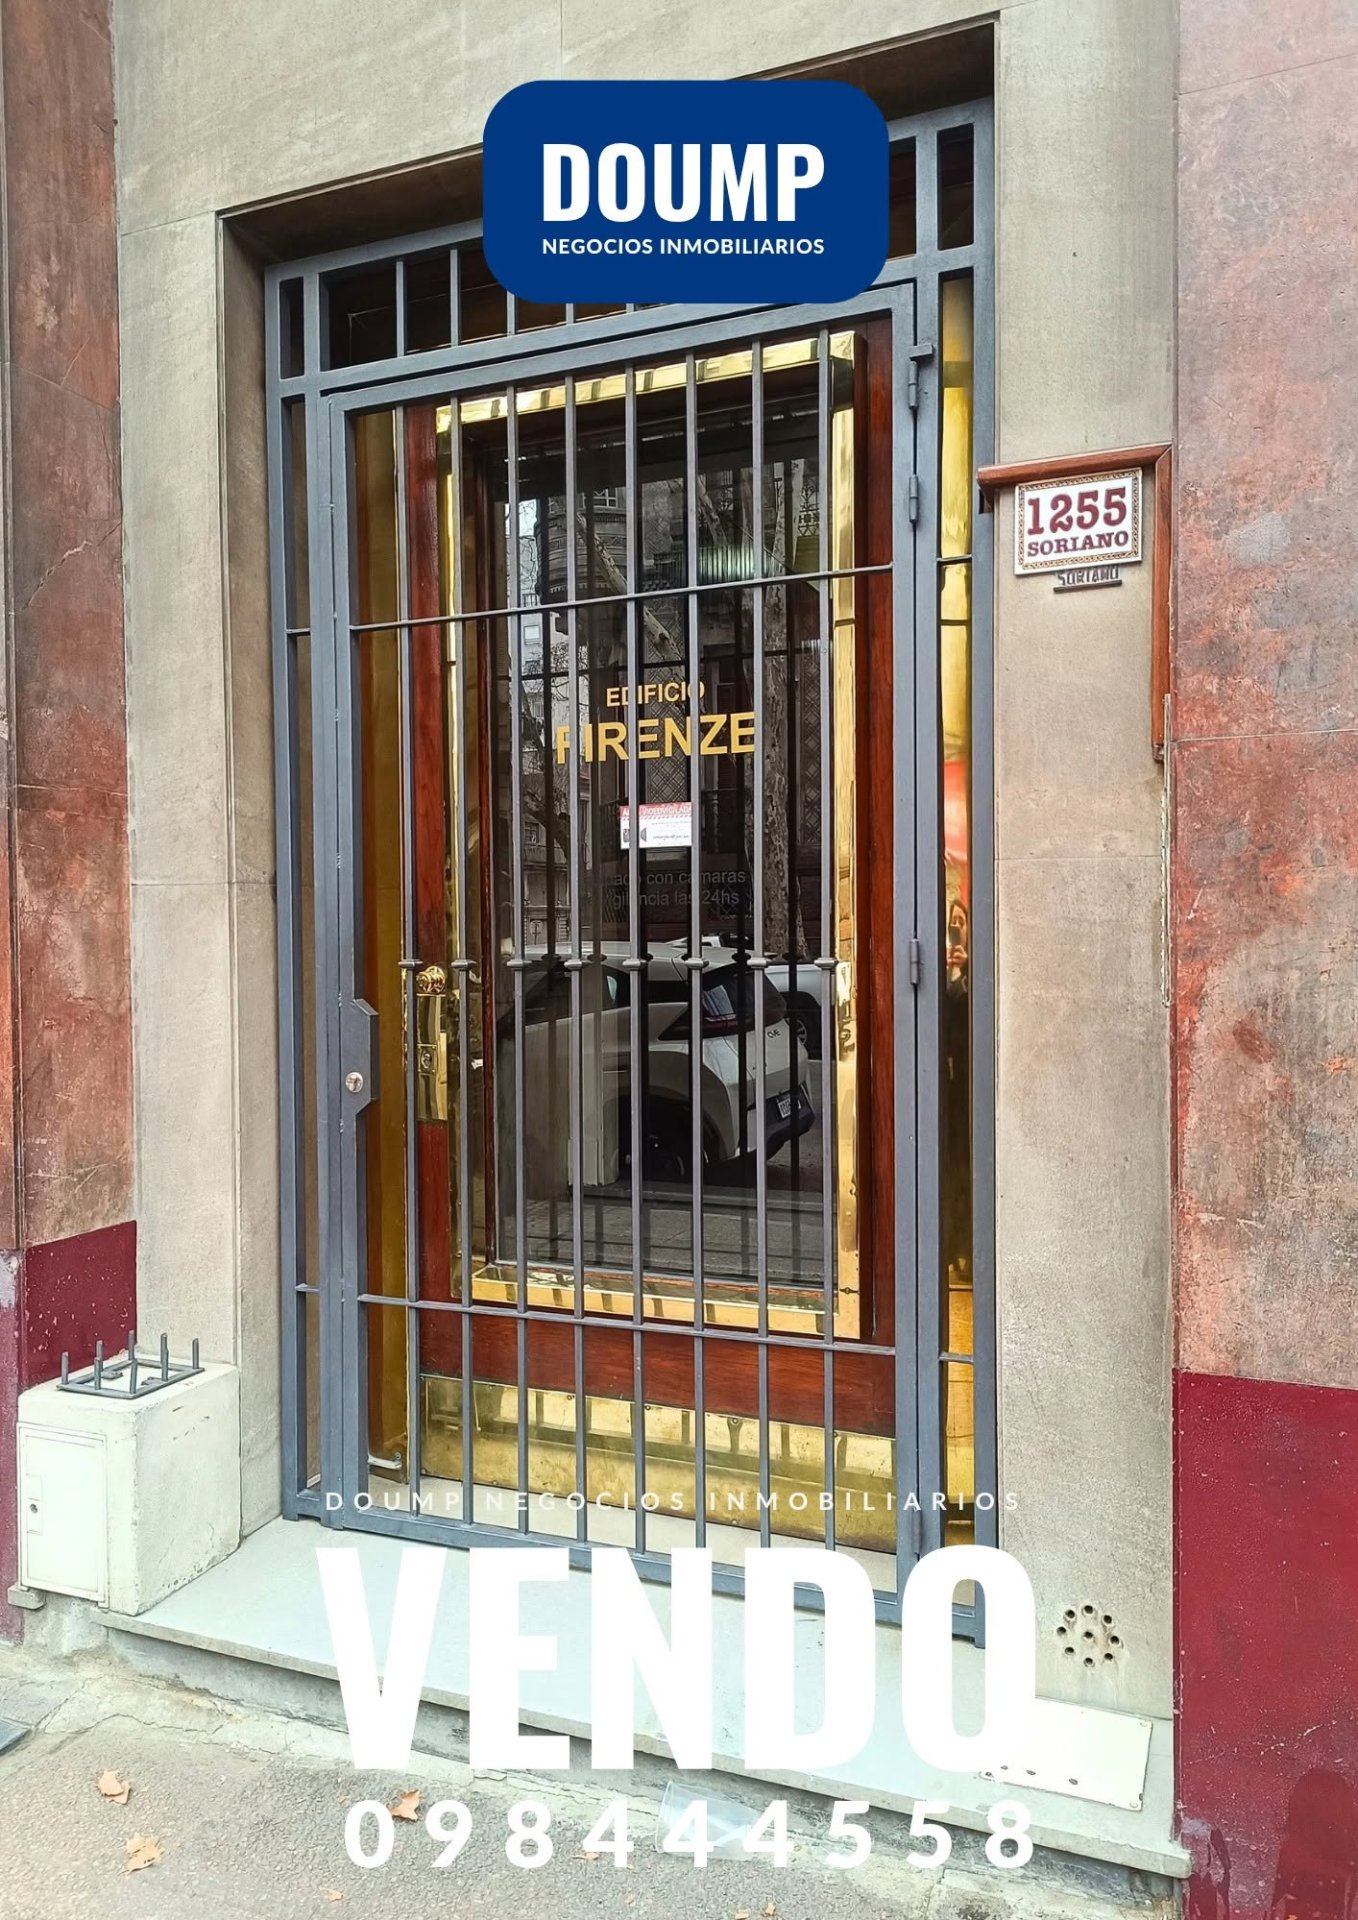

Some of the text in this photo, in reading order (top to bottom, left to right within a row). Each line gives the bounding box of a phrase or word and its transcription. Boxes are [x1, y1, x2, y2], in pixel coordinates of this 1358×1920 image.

[1027, 486, 1127, 536] 1255
[1027, 531, 1129, 558] SORIANO
[556, 711, 755, 764] FIRENZE
[646, 873, 673, 885] con
[703, 888, 740, 905] 24hs
